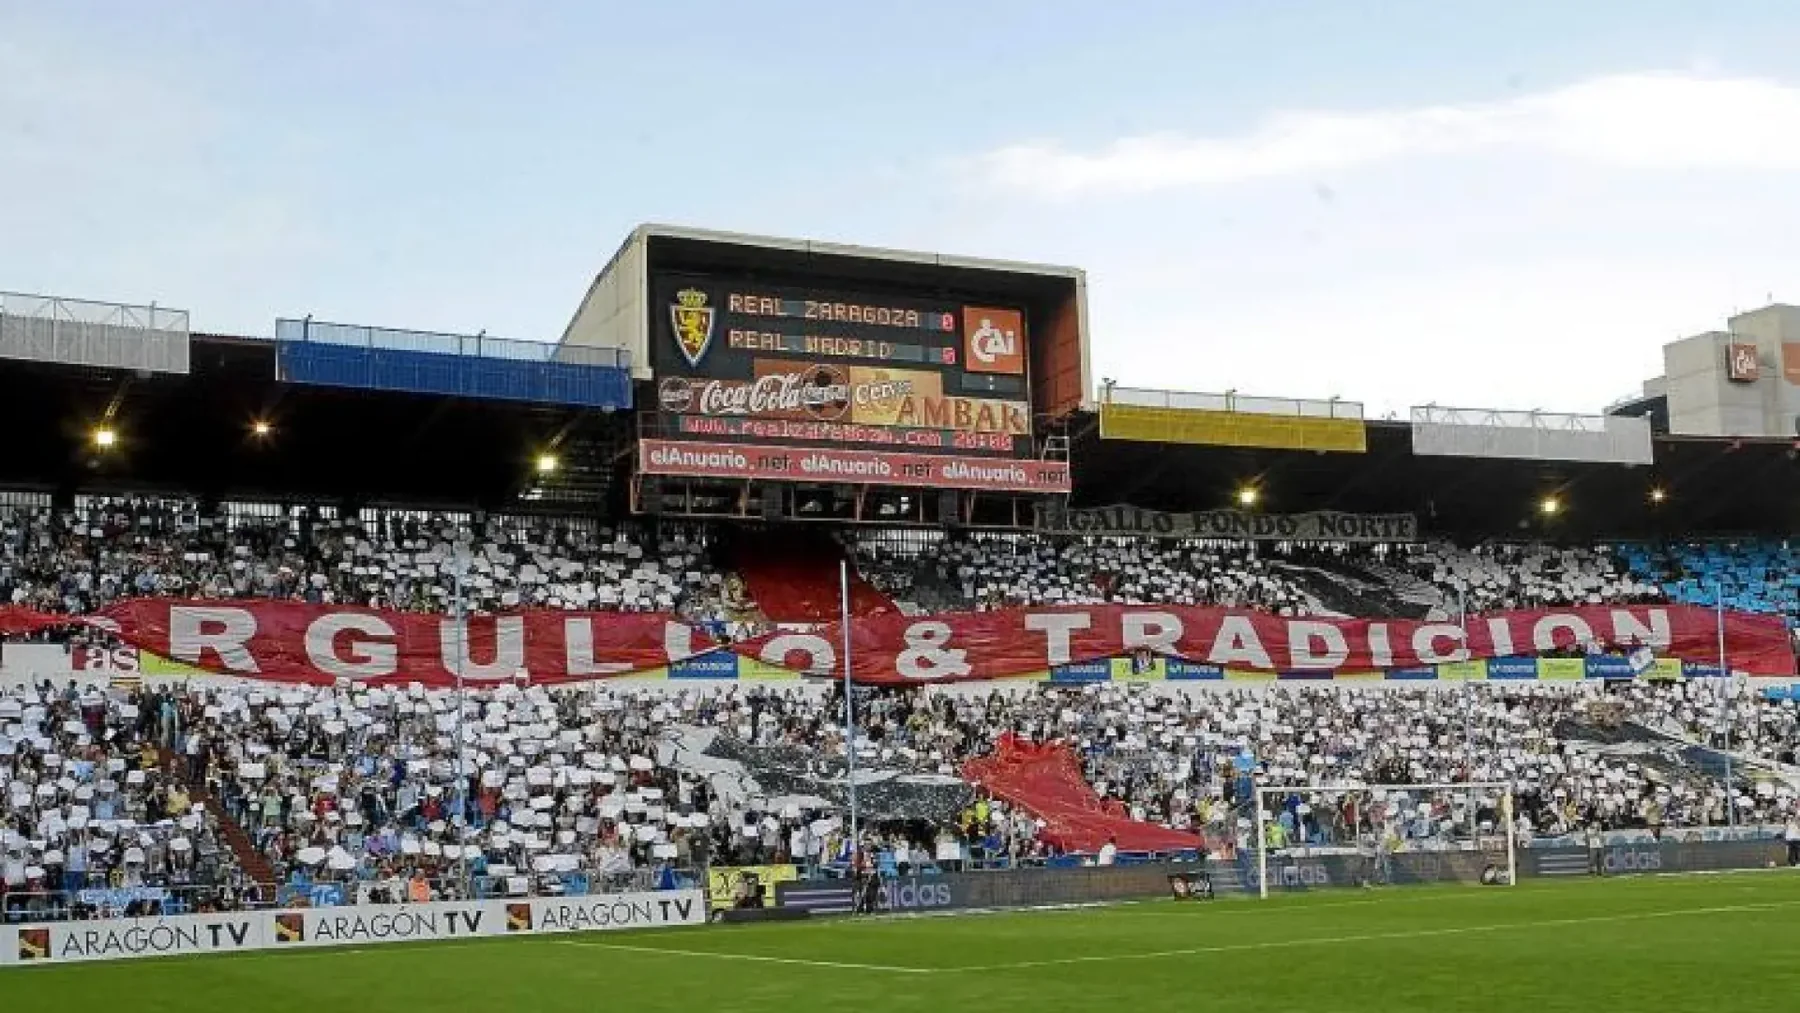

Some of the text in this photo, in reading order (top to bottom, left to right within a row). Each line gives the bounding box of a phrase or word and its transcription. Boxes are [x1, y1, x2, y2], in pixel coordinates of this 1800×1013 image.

[729, 293, 787, 315] REAL
[804, 301, 920, 327] ZARAGOZA
[729, 330, 789, 350] REAL
[1195, 512, 1297, 537] FONDO
[1318, 512, 1415, 538] NORTE
[896, 621, 972, 679] &
[314, 905, 485, 940] ARAGÓN TV
[541, 896, 692, 930] ARAGÓN TV
[61, 919, 250, 956] ARAGÓN TV
